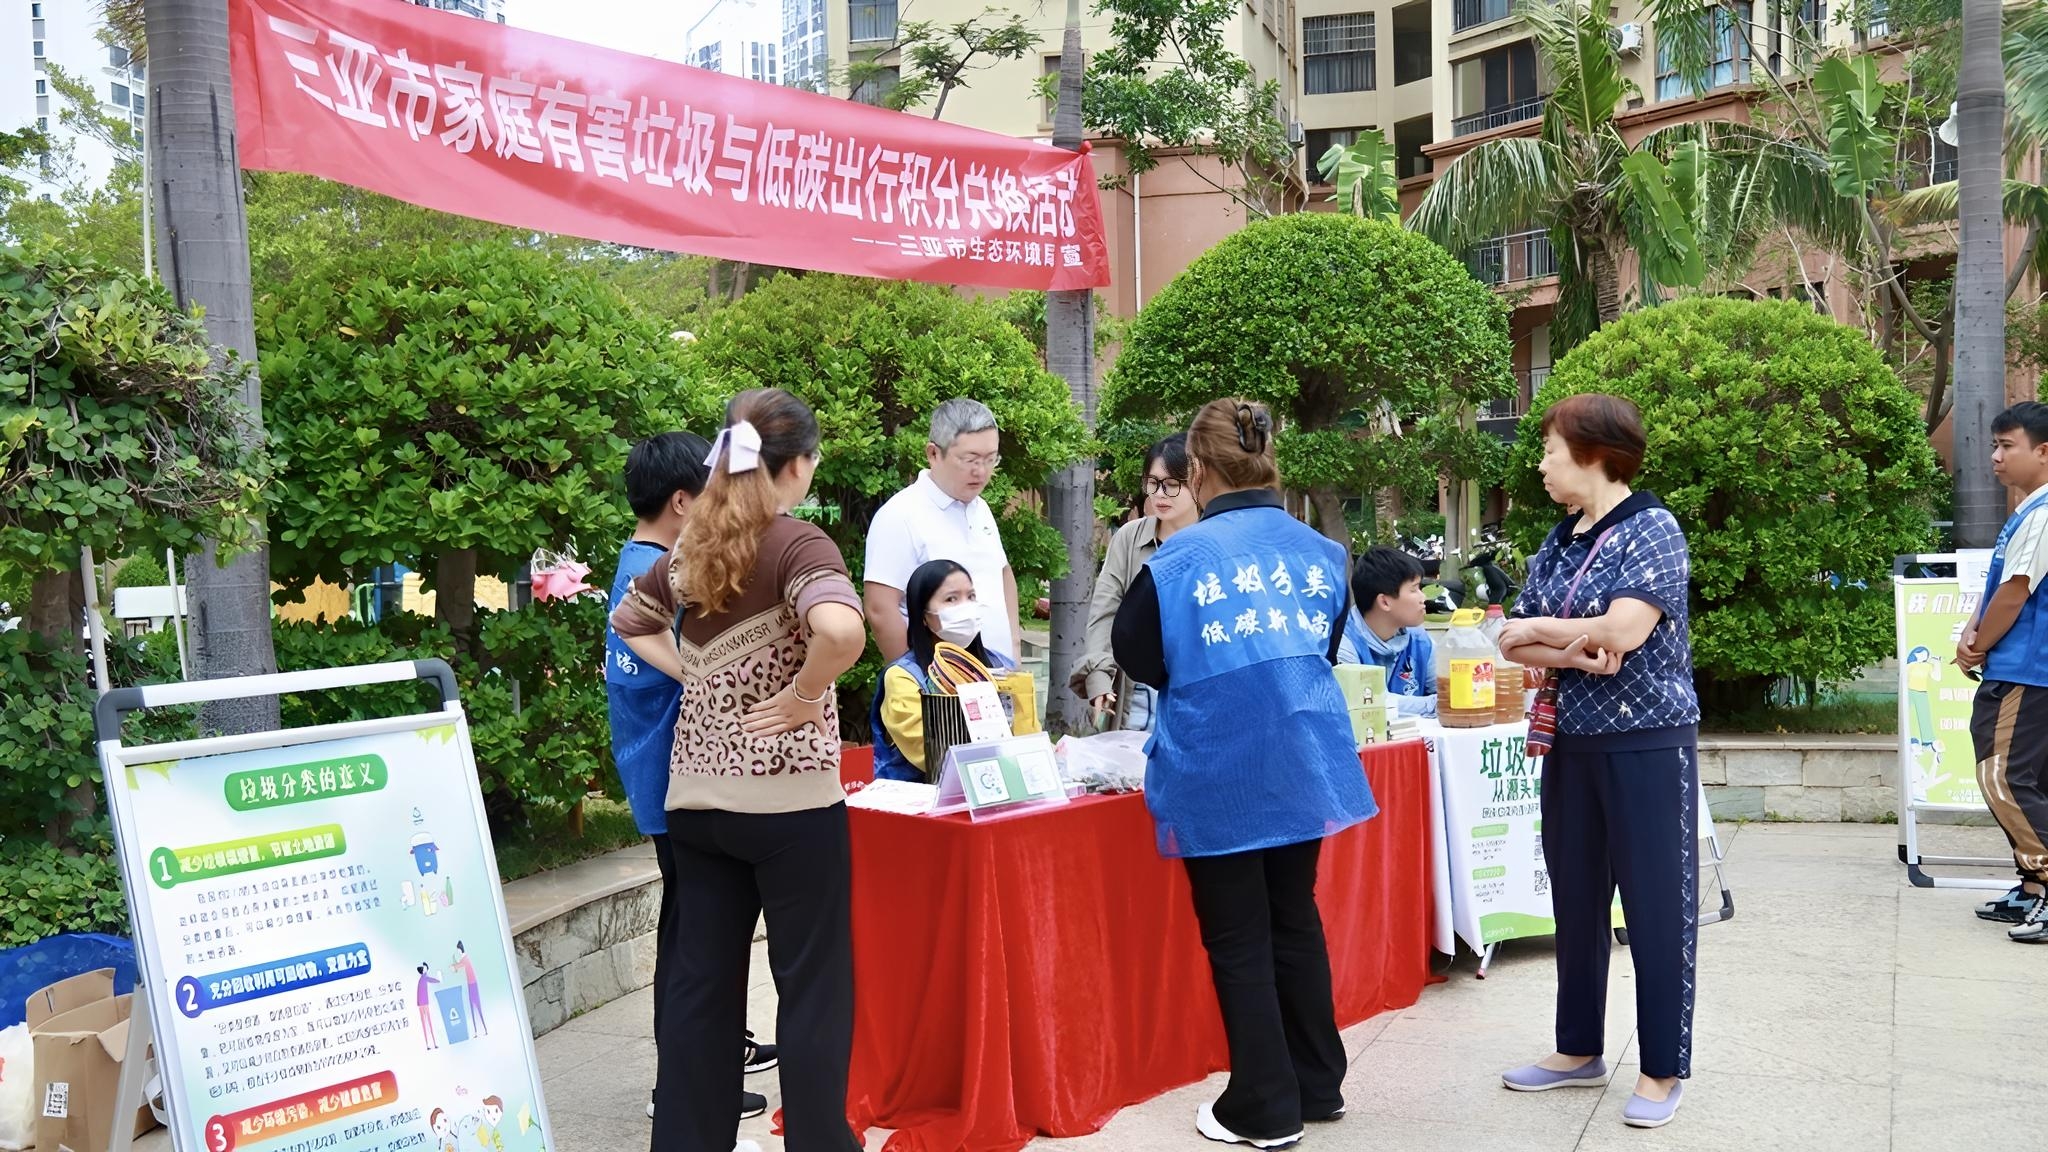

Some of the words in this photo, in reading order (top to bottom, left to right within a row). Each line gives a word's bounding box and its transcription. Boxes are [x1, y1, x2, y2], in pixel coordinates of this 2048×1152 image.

[267, 14, 1079, 238] 三亚市家庭有害垃圾与低碳出行积分兑换活动
[1193, 561, 1332, 606] 垃圾分类
[1480, 736, 1538, 779] 垃圾
[239, 762, 375, 804] 垃圾分类的意义
[157, 855, 173, 882] 1
[182, 982, 199, 1012] 2
[211, 1122, 229, 1152] 3
